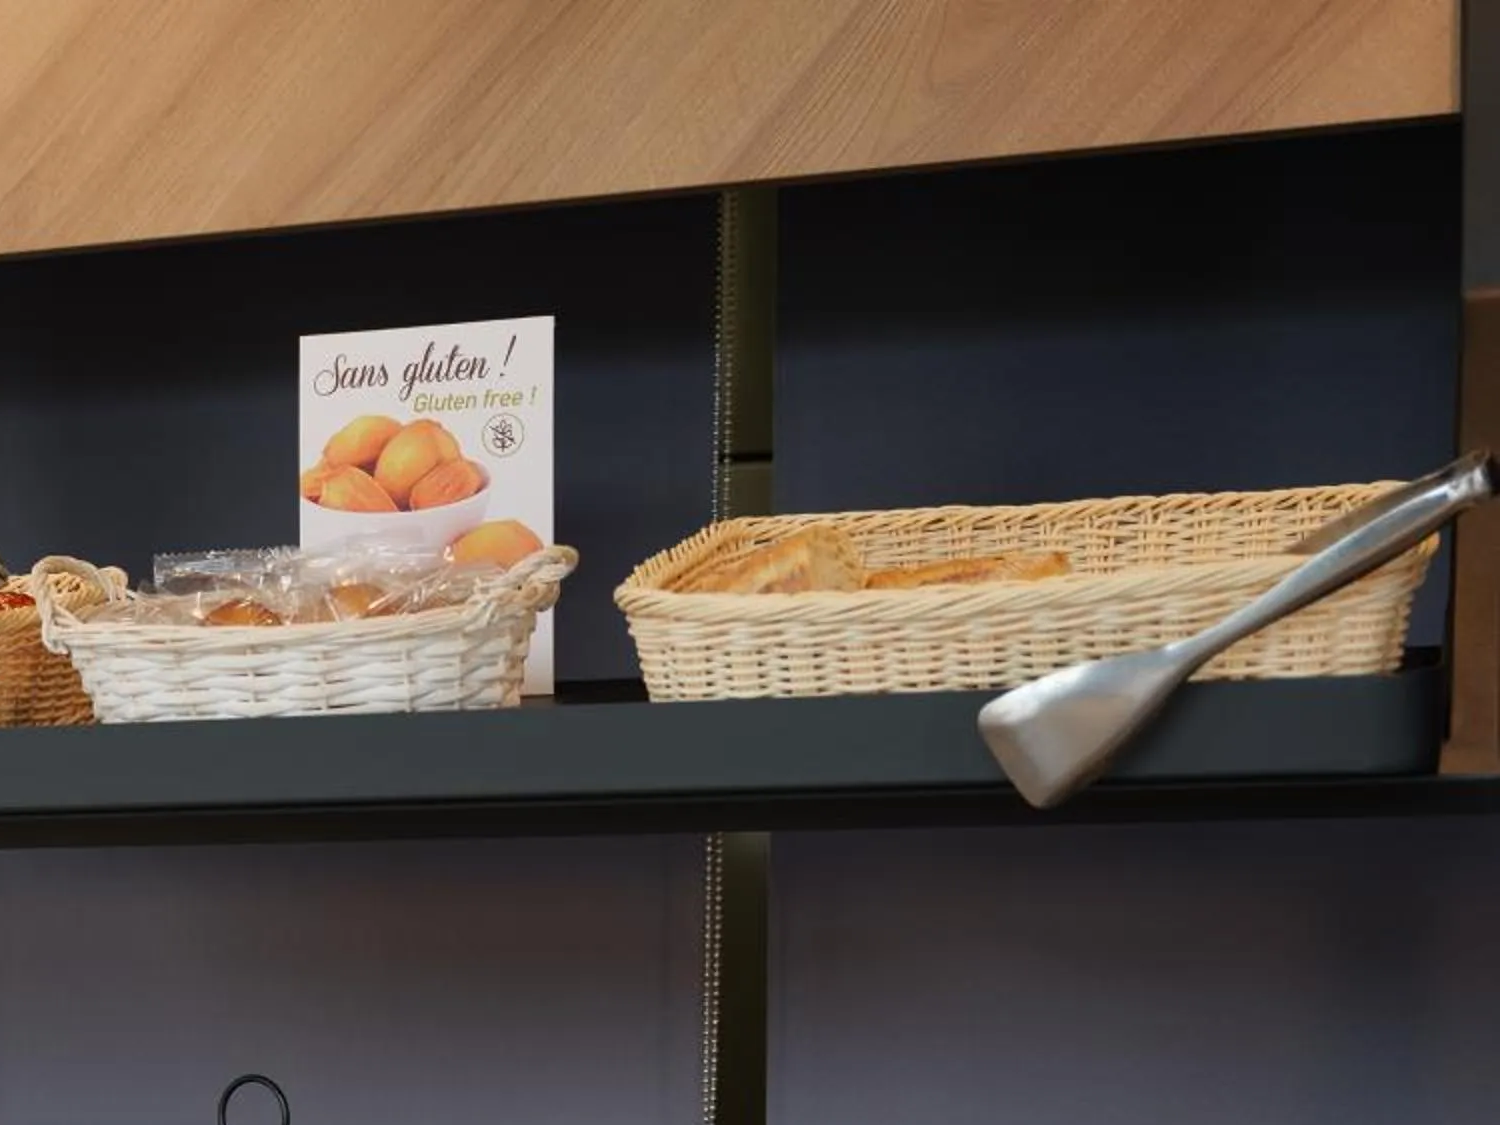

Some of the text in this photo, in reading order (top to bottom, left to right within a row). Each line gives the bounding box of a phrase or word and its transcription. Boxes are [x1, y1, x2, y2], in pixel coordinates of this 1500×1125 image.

[313, 334, 518, 401] Sans gluten !
[412, 385, 539, 413] Gluten free !
